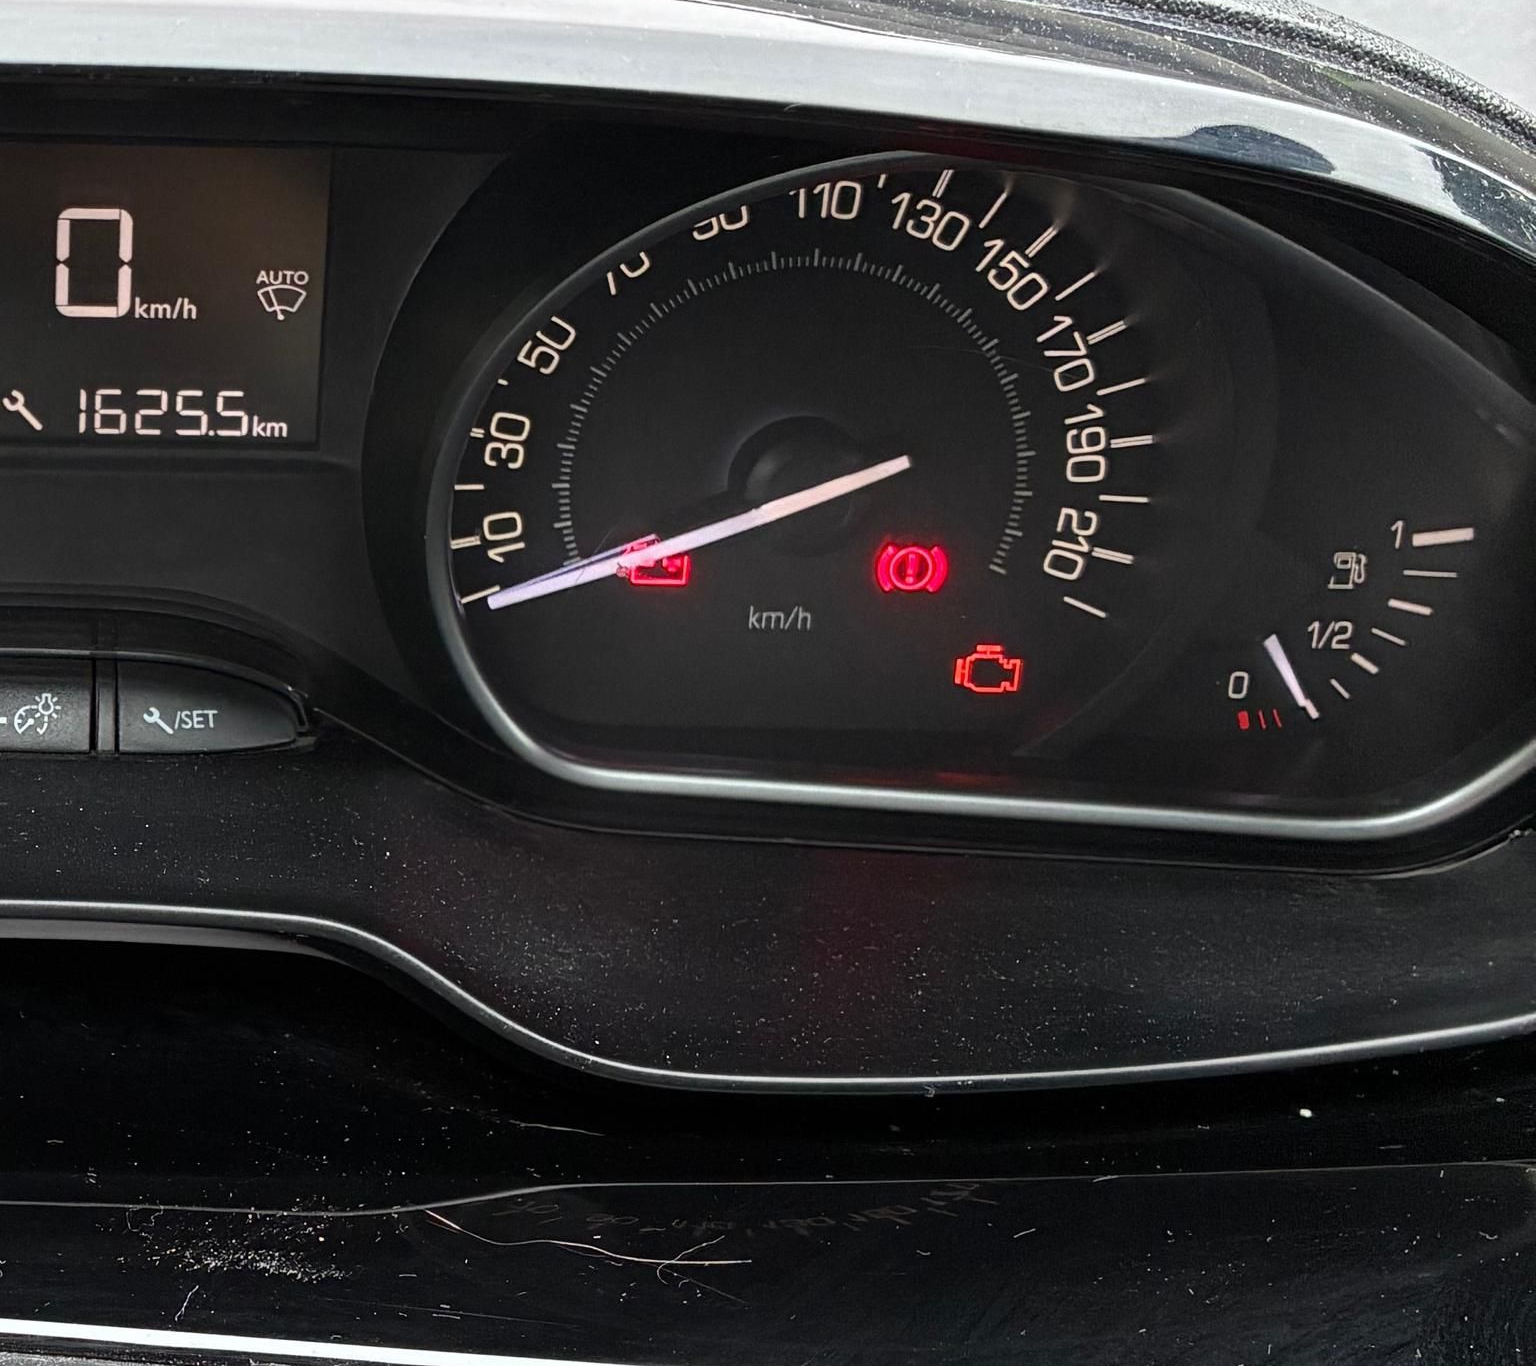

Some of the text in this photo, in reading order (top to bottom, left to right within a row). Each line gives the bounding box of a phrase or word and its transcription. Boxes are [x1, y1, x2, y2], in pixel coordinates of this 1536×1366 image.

[789, 180, 862, 220] 110
[891, 191, 971, 251] 130
[55, 207, 197, 320] 0 km/h
[256, 270, 309, 285] AUTO
[975, 238, 1050, 311] 150
[1036, 315, 1096, 393] 170
[78, 388, 288, 438] 1625.5 km
[483, 411, 531, 470] 30
[1064, 403, 1107, 483] 190
[482, 511, 526, 564] 10
[1043, 506, 1099, 581] 210
[1390, 520, 1404, 549] 1
[747, 605, 812, 631] km/h
[1307, 620, 1353, 650] 1/2
[1227, 670, 1250, 699] 0
